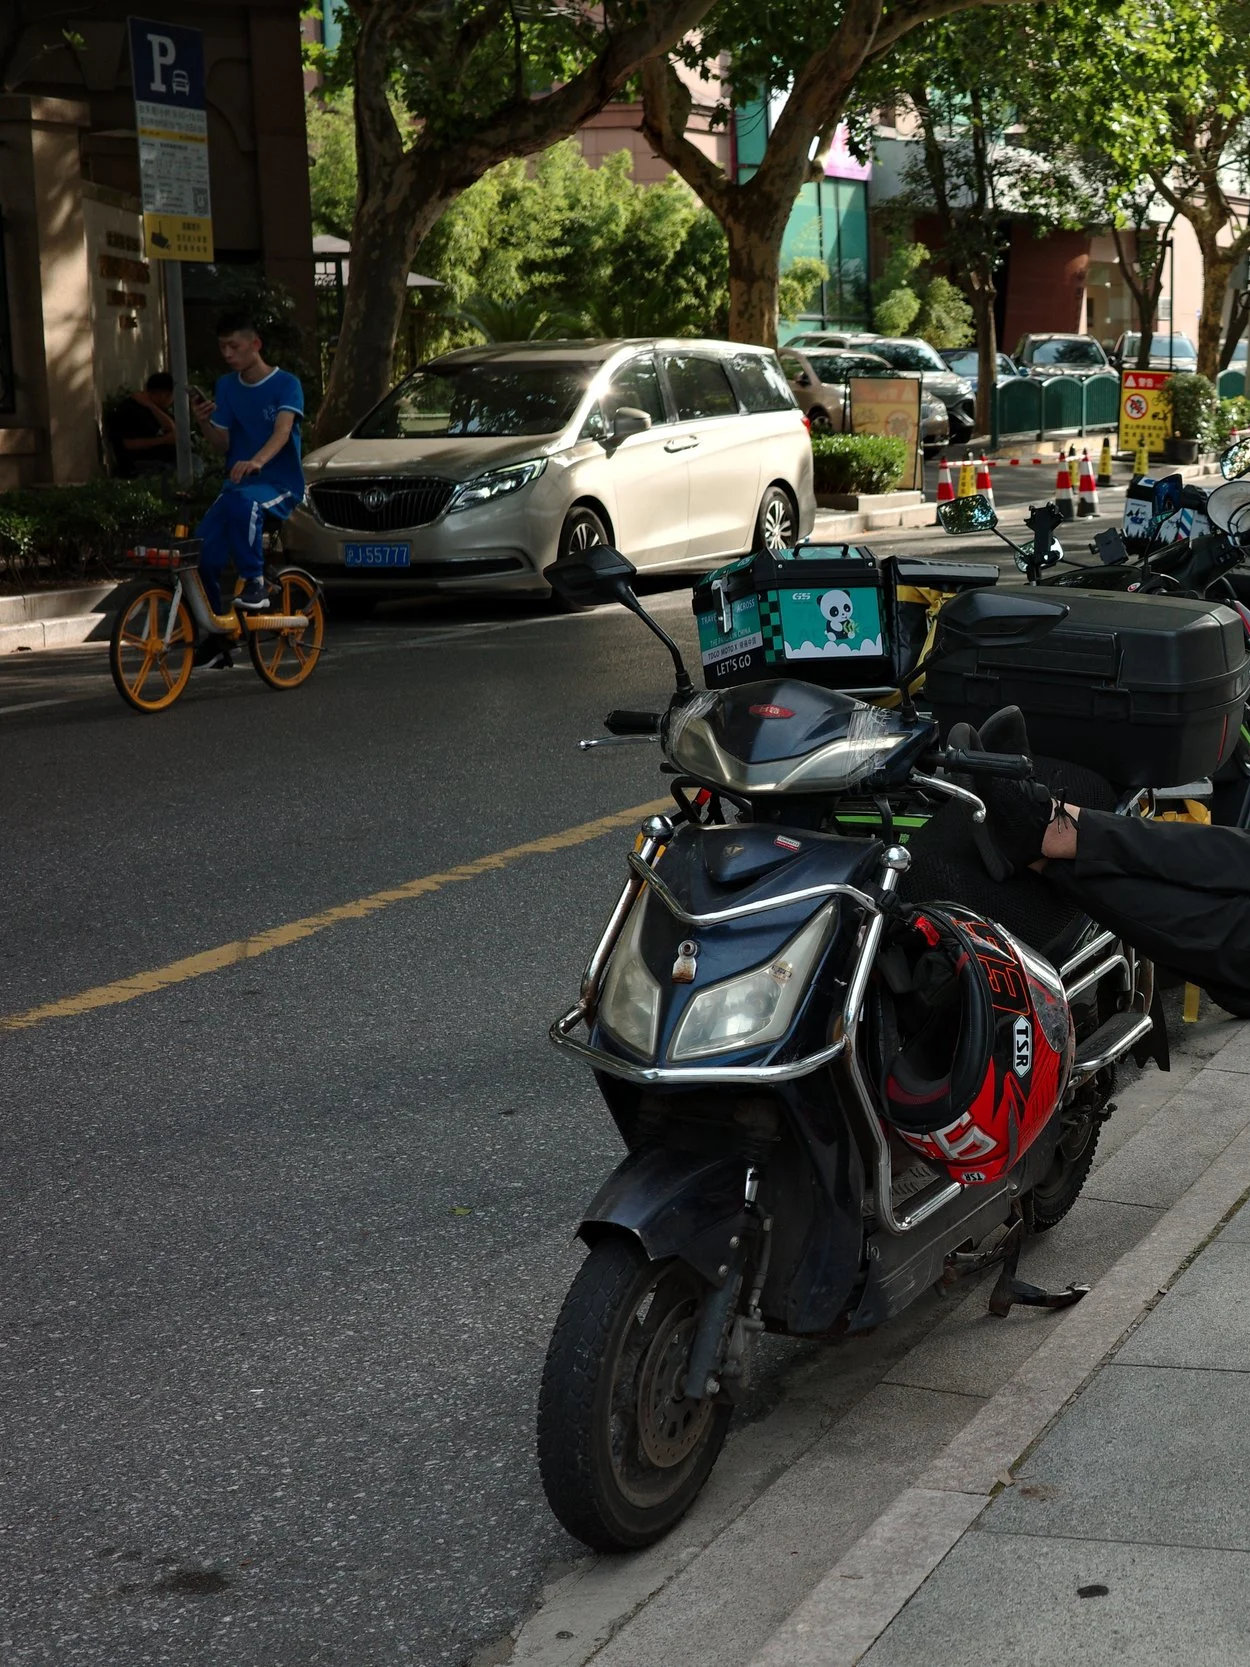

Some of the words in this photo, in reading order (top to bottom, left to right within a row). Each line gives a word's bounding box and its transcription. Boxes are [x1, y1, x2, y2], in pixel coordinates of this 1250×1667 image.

[146, 32, 177, 93] P
[736, 598, 756, 612] ACROSS
[716, 657, 738, 677] LET'S
[738, 654, 752, 669] GO
[1015, 1025, 1029, 1068] TSR
[964, 1172, 984, 1182] TSR
